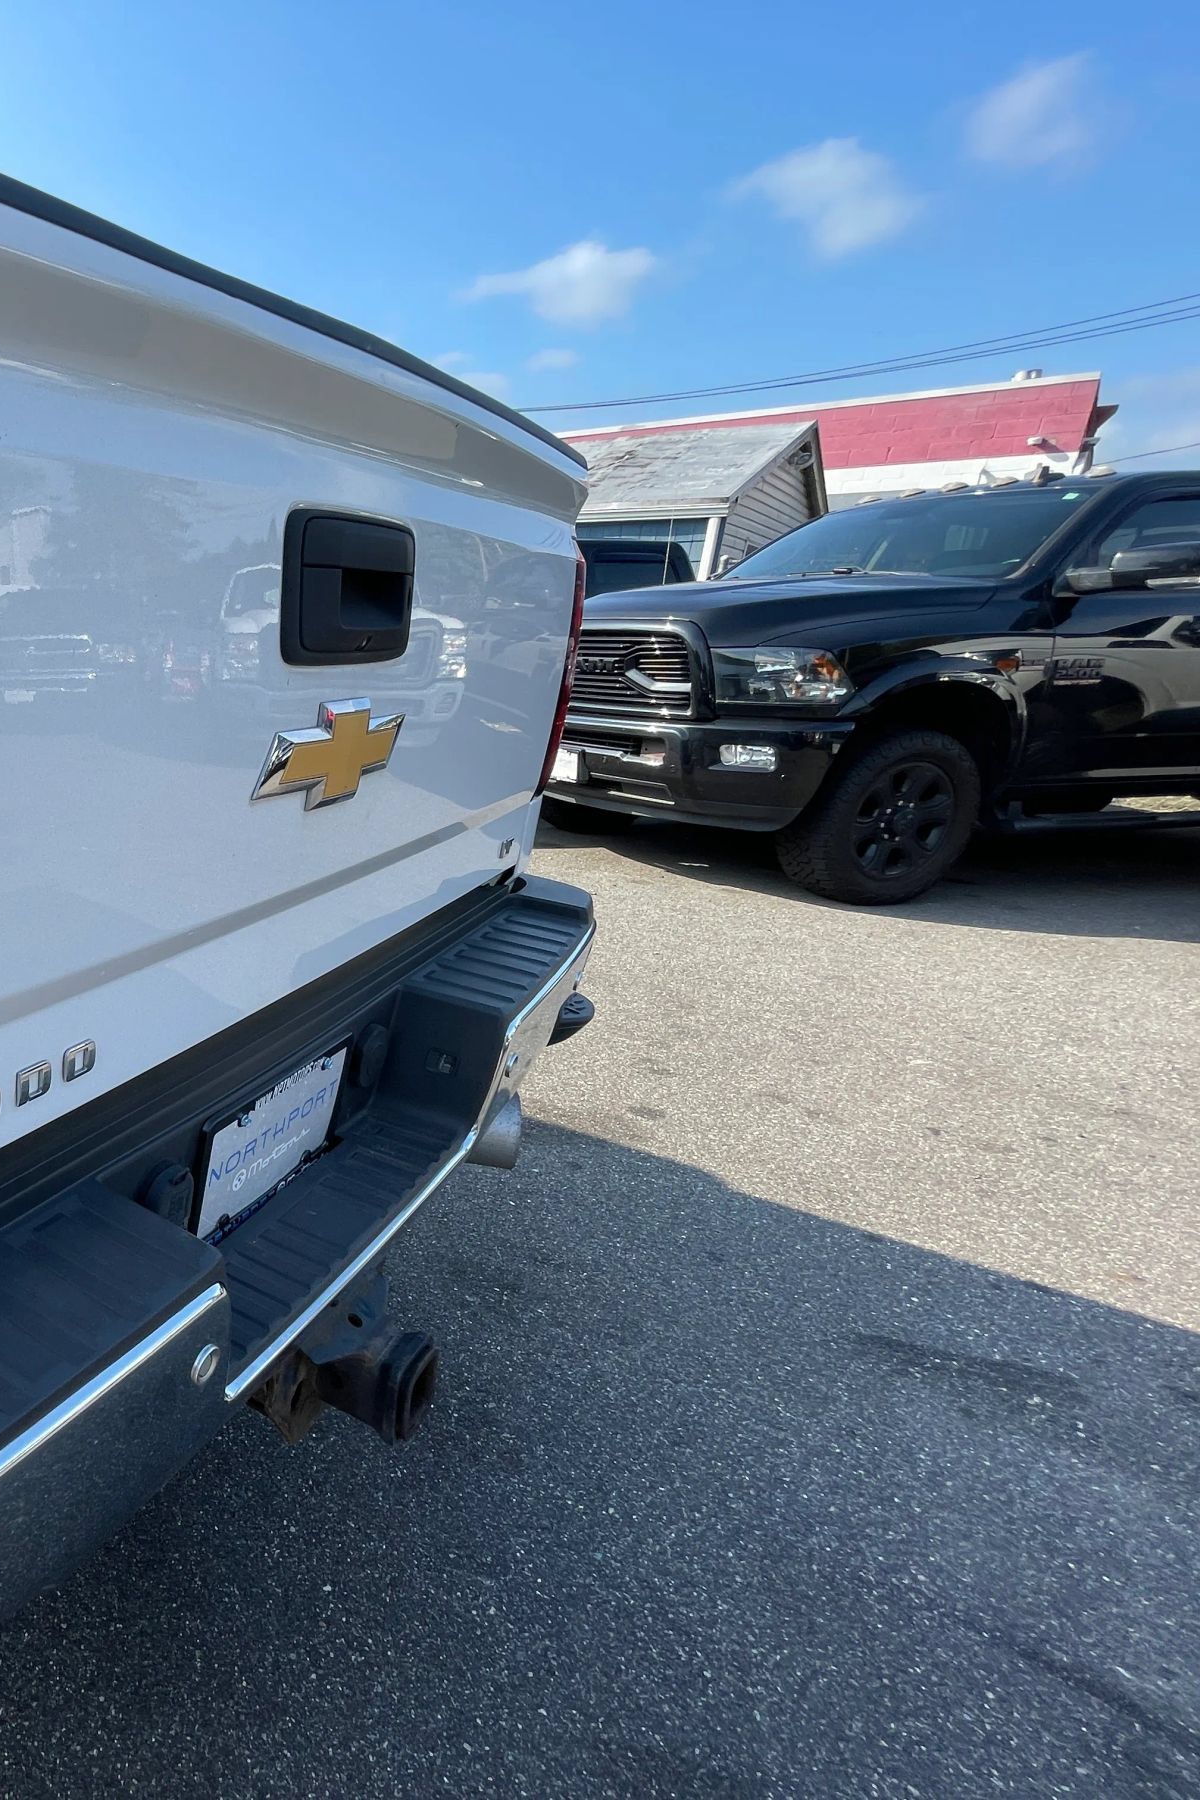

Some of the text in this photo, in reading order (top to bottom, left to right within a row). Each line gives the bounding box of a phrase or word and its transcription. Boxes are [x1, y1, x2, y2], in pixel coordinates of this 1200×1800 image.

[1055, 657, 1105, 669] RAM
[1054, 669, 1104, 679] 2500
[208, 1079, 338, 1187] NORTHPORT
